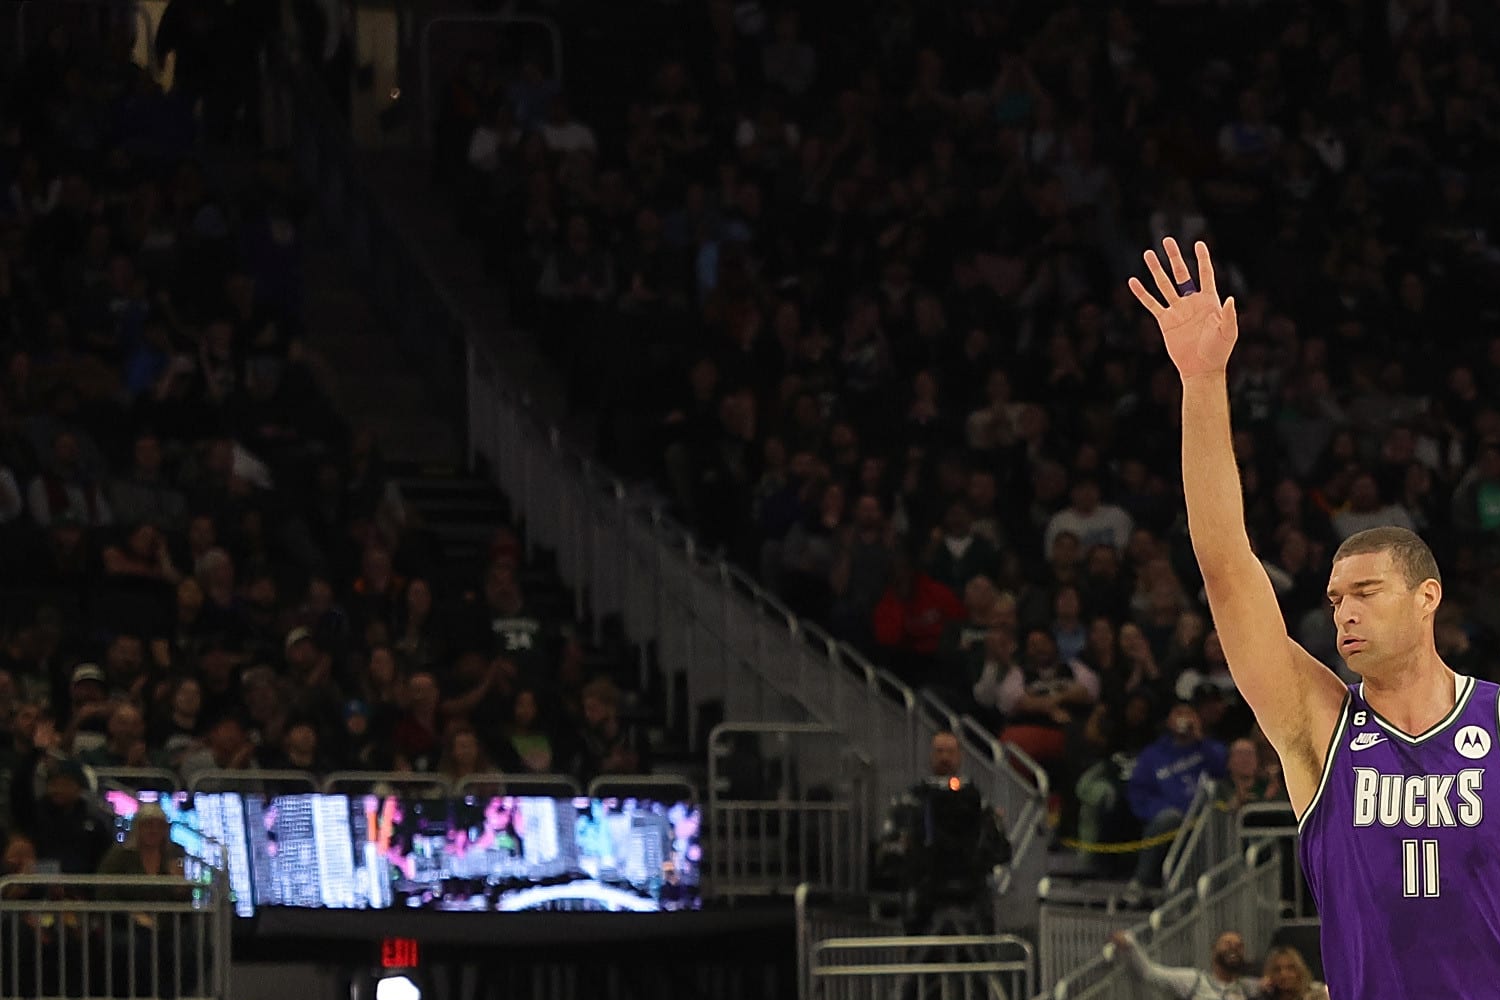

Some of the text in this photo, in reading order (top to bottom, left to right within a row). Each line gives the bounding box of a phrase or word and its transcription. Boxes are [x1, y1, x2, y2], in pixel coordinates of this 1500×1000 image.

[1353, 711, 1367, 726] 6
[1352, 767, 1486, 828] BUCKS
[1402, 839, 1440, 898] 11
